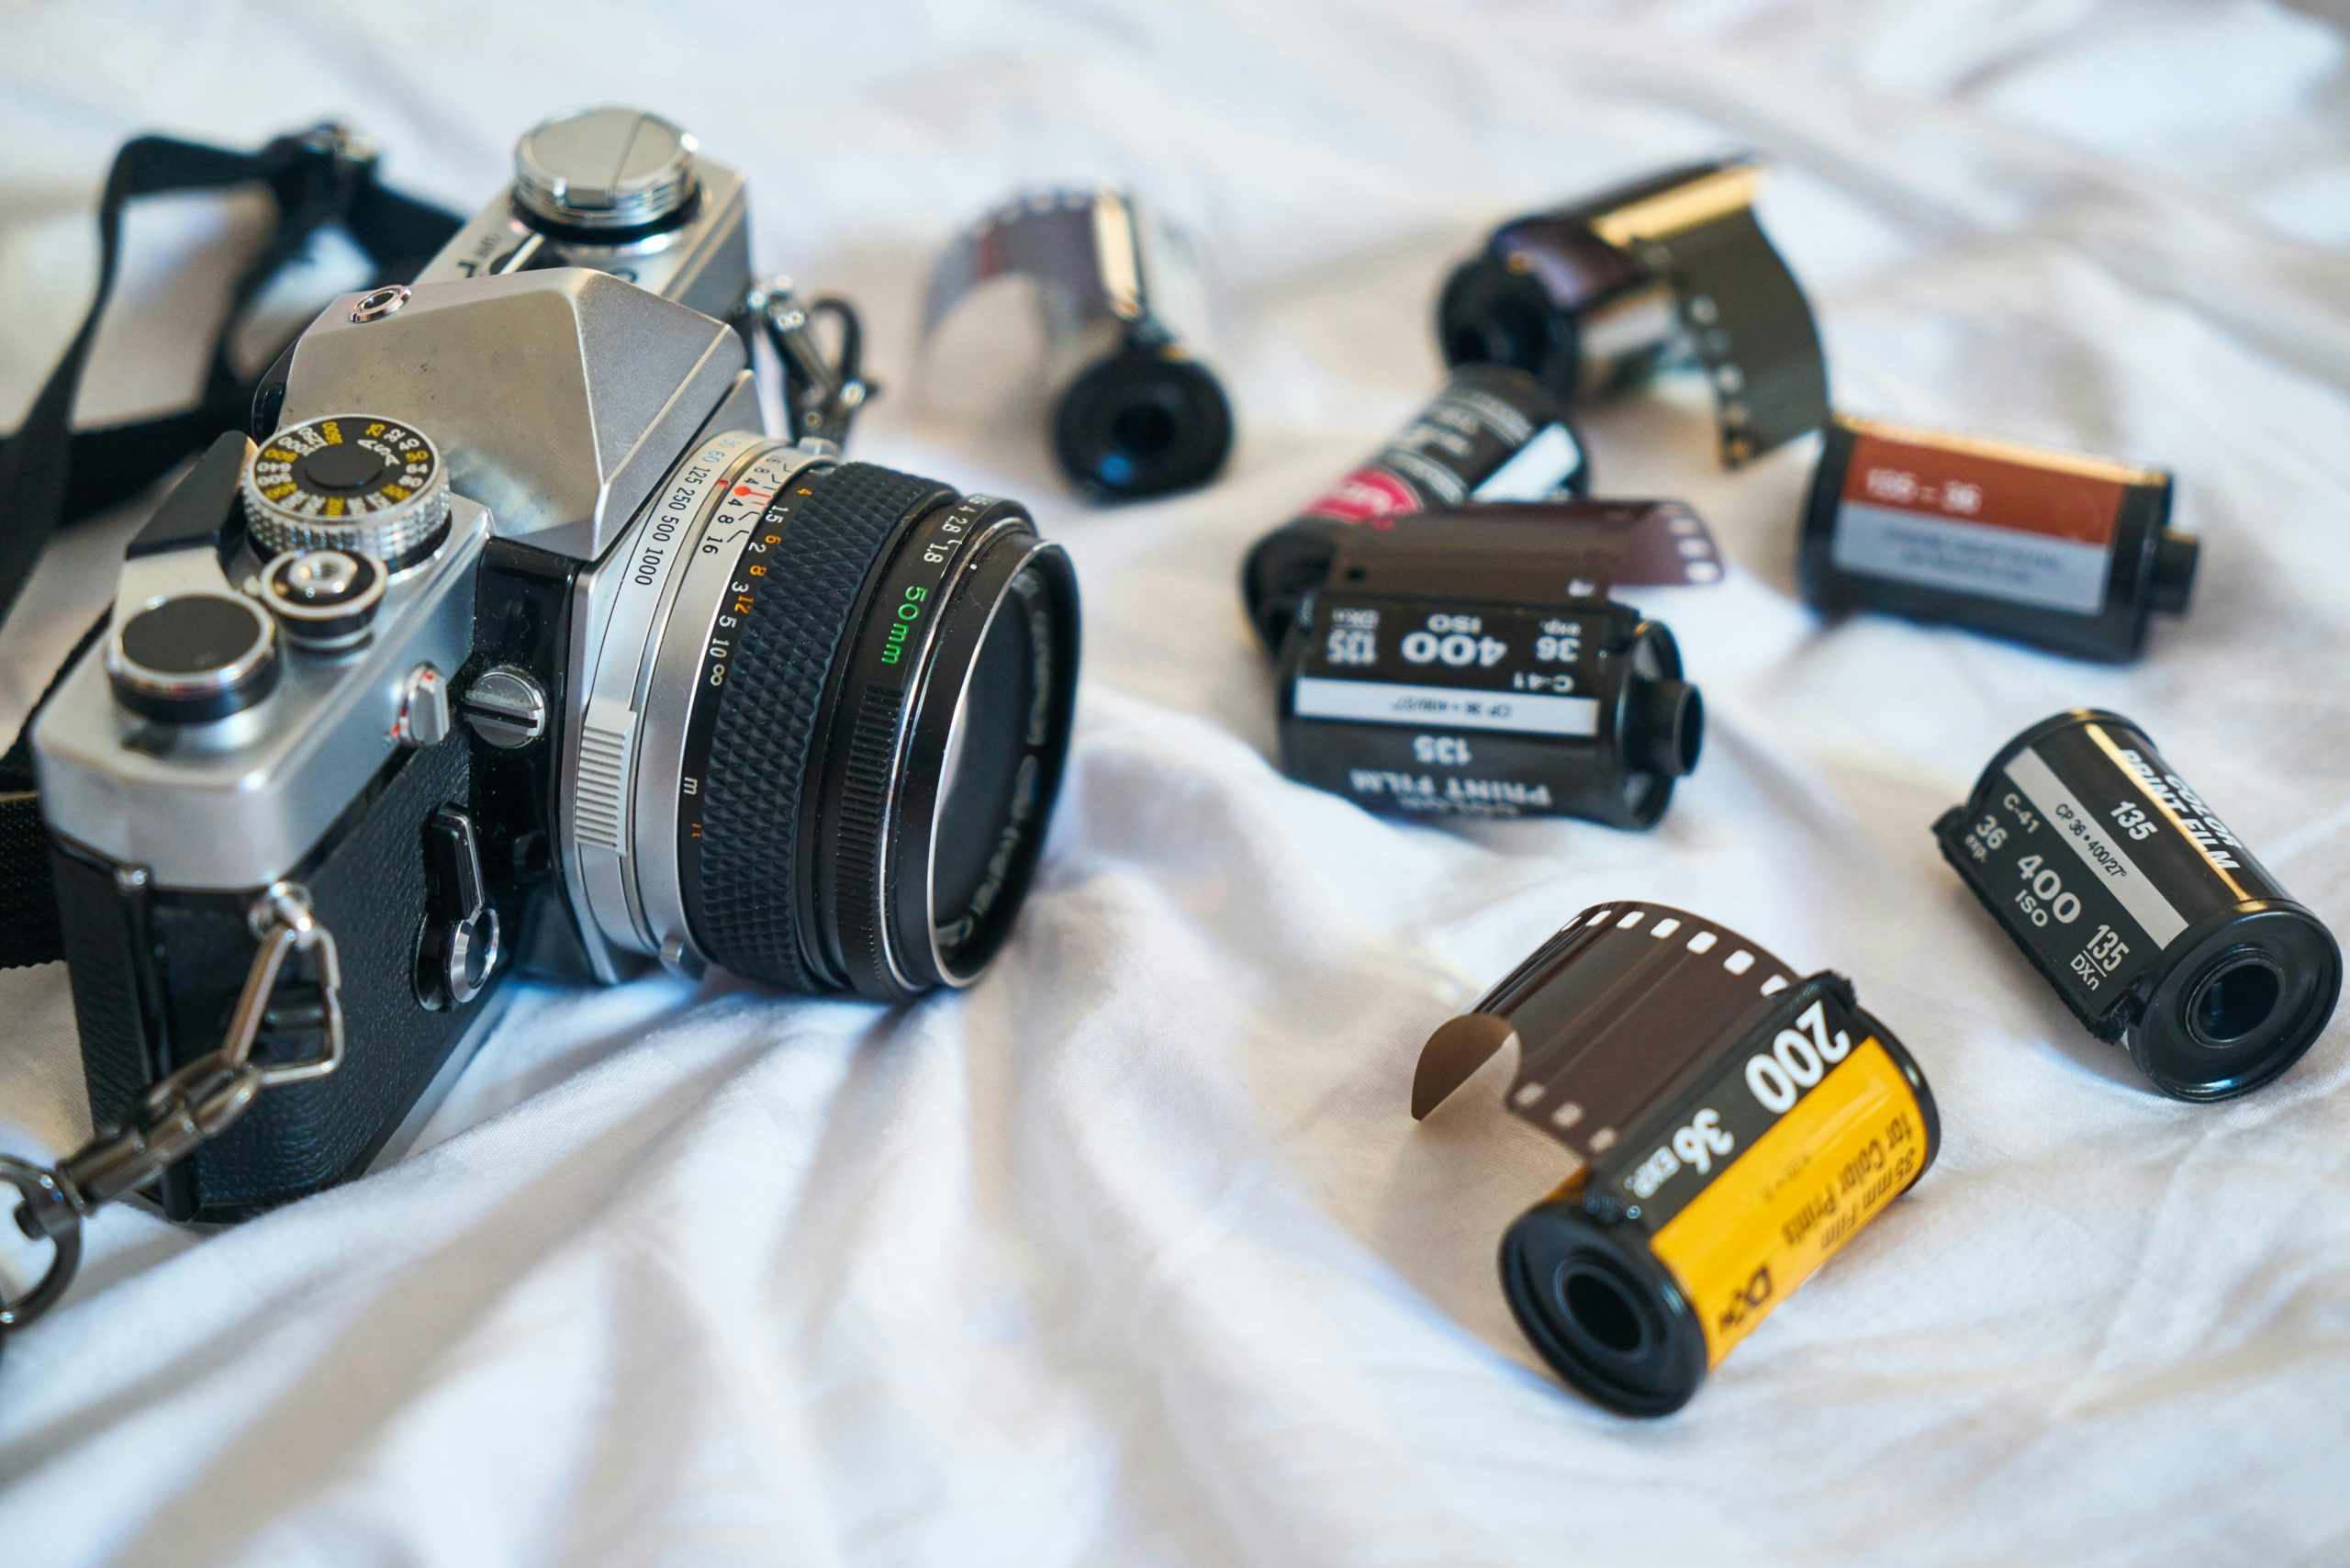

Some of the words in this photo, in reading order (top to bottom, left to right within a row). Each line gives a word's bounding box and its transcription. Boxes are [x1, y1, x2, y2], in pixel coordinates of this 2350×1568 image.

[384, 428, 407, 443] 32
[398, 438, 420, 451] 40
[357, 439, 401, 467] ASA
[405, 464, 429, 474] 64
[685, 465, 711, 485] 125
[668, 487, 695, 510] 250
[653, 515, 679, 542] 500
[717, 514, 734, 524] 8
[702, 535, 723, 554] 16
[748, 542, 767, 553] 2
[635, 546, 664, 586] 1000
[750, 565, 767, 577] 8
[732, 582, 749, 593] 3
[719, 613, 737, 630] 5
[881, 586, 929, 665] 50mm
[710, 637, 731, 658] 10
[1401, 632, 1506, 666] 400
[1536, 637, 1580, 662] 36
[1514, 672, 1574, 692] C-41
[1414, 735, 1472, 766] 135
[2003, 793, 2041, 834] C-41
[2055, 804, 2075, 820] CP
[2069, 820, 2087, 836] 36
[2110, 801, 2158, 840] 135
[2165, 775, 2243, 848] COLOR
[1975, 815, 2009, 850] 36
[2178, 819, 2240, 869] FILM
[2017, 855, 2081, 924] 400
[2014, 889, 2049, 927] ISO
[2087, 924, 2130, 971] 135
[2070, 954, 2100, 991] DXn
[1745, 1000, 1850, 1114] 200
[1673, 1107, 1734, 1175] 36
[1886, 1112, 1911, 1151] for
[1839, 1138, 1885, 1195] Color
[1781, 1181, 1837, 1245] Prints
